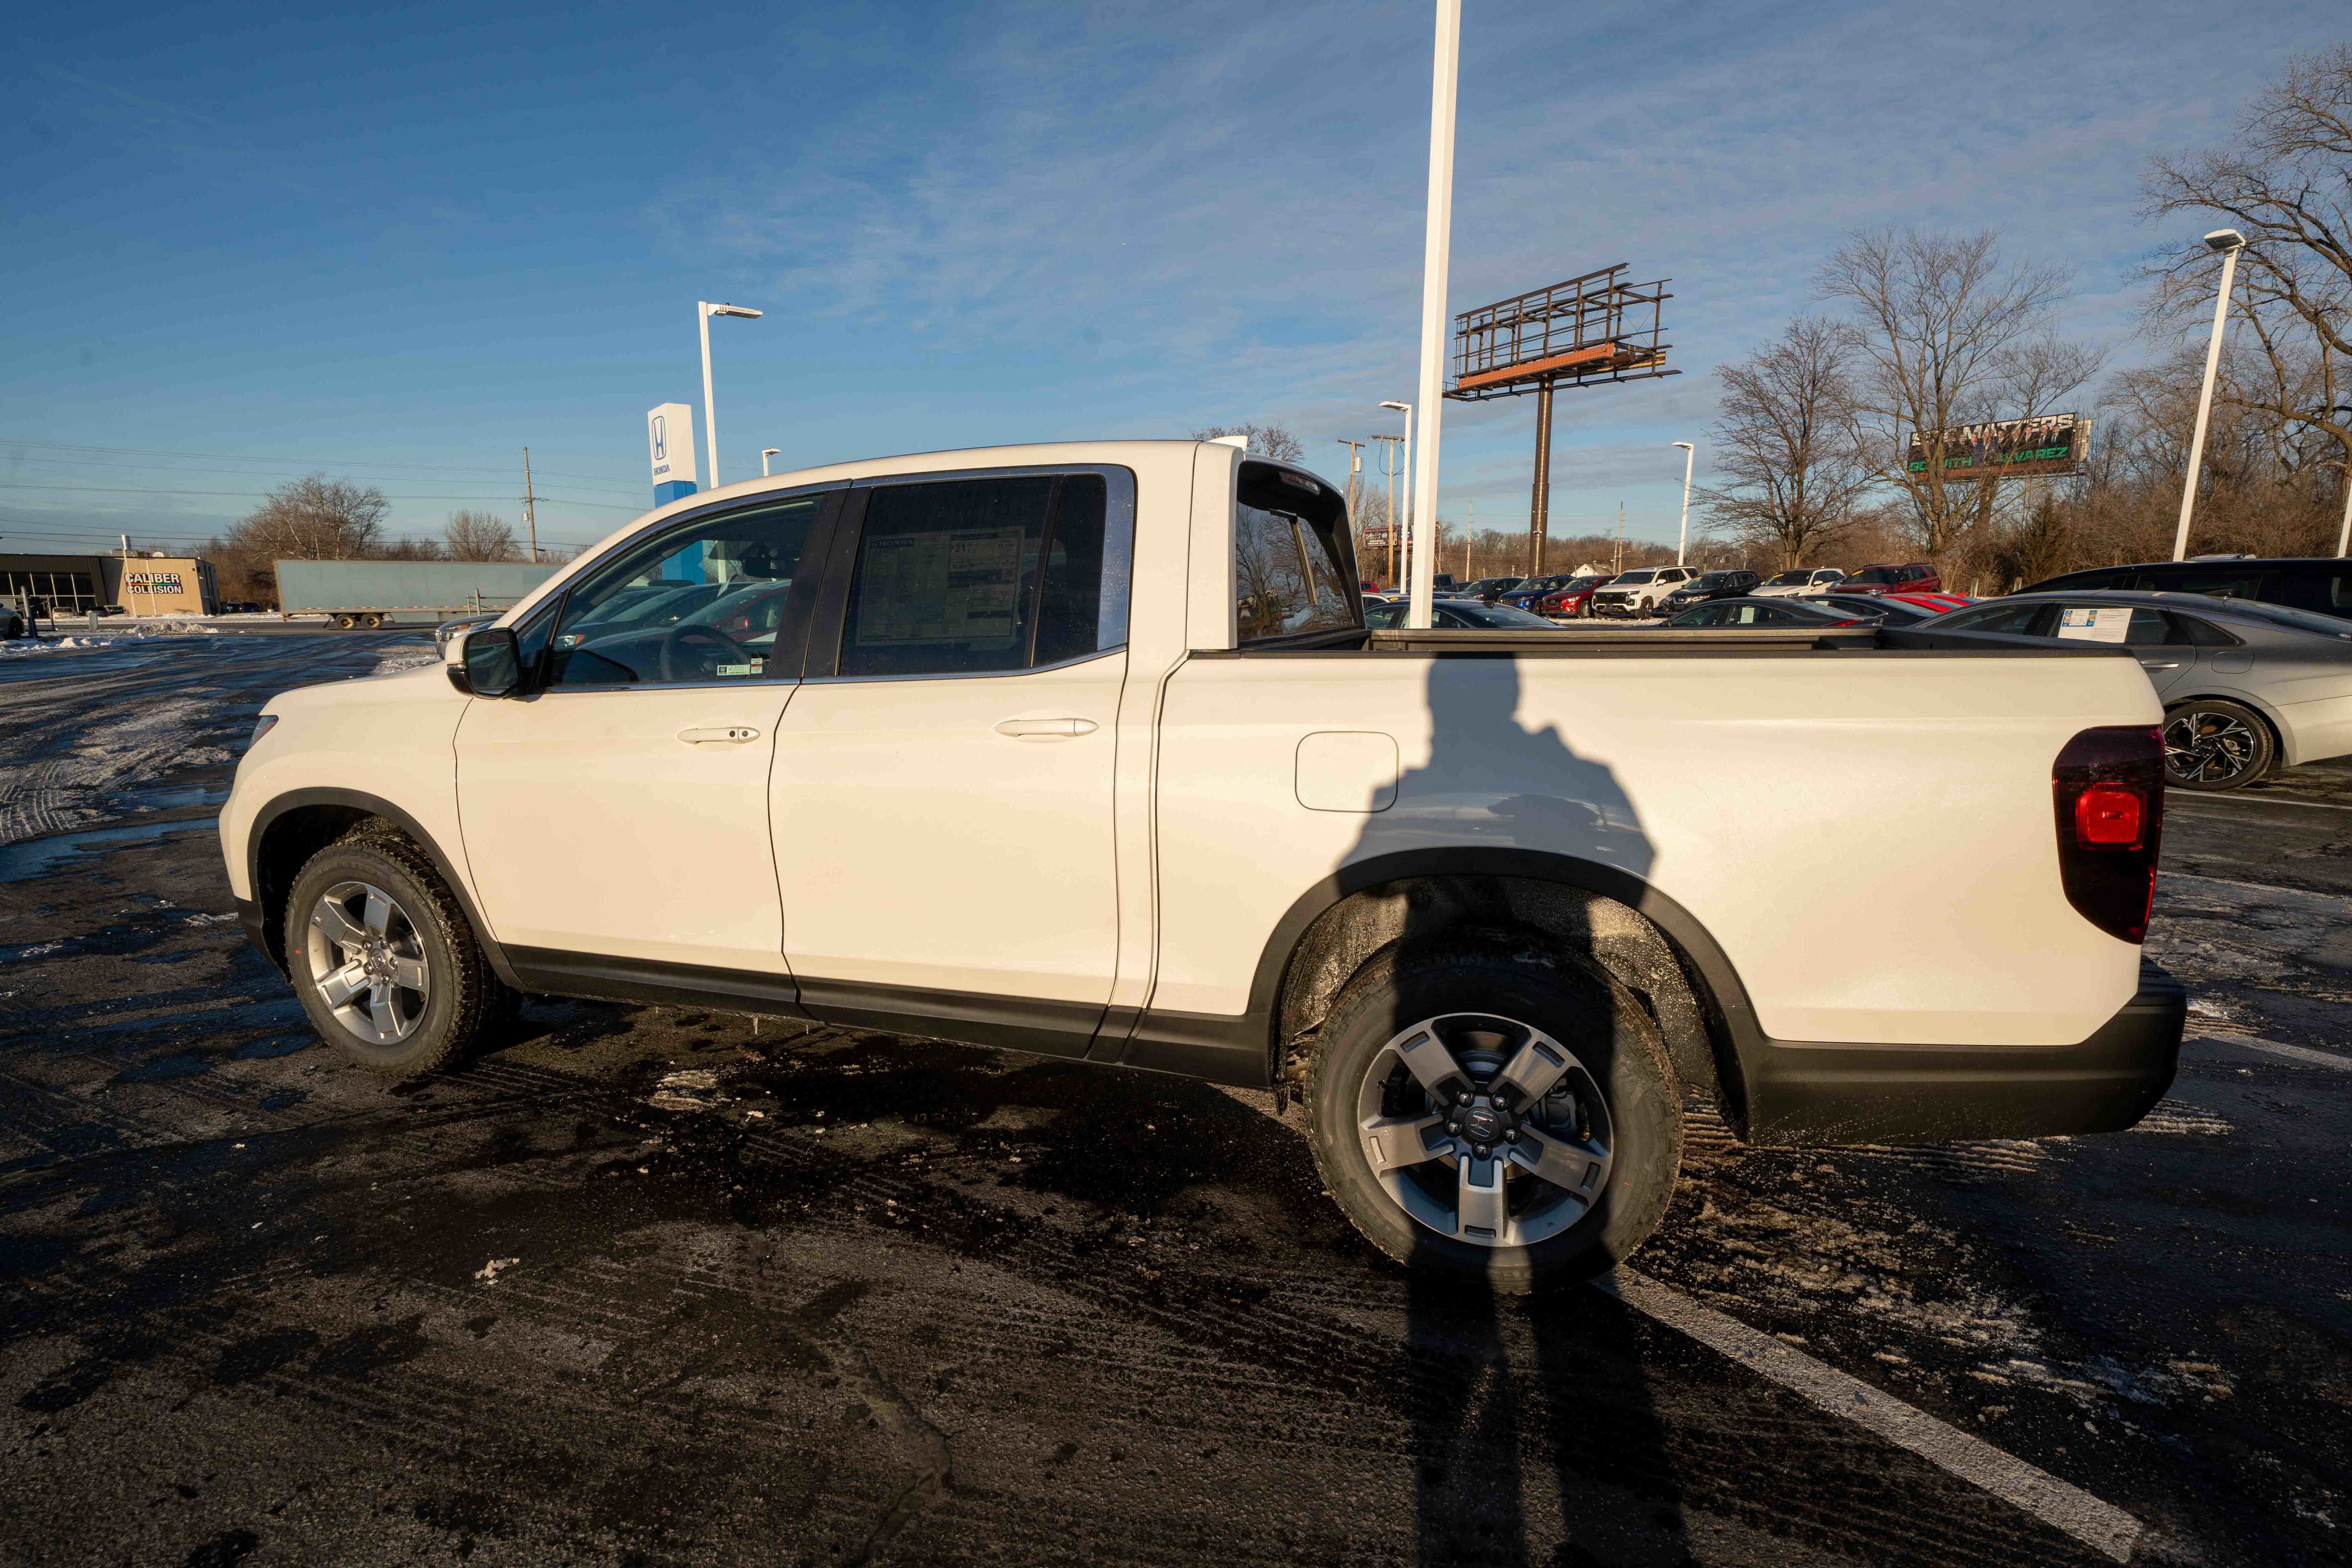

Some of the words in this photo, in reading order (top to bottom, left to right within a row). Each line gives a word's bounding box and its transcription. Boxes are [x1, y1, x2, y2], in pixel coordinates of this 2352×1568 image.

[654, 464, 670, 475] HONDA
[125, 573, 180, 583] CALIBER
[127, 585, 182, 594] COLLISION
